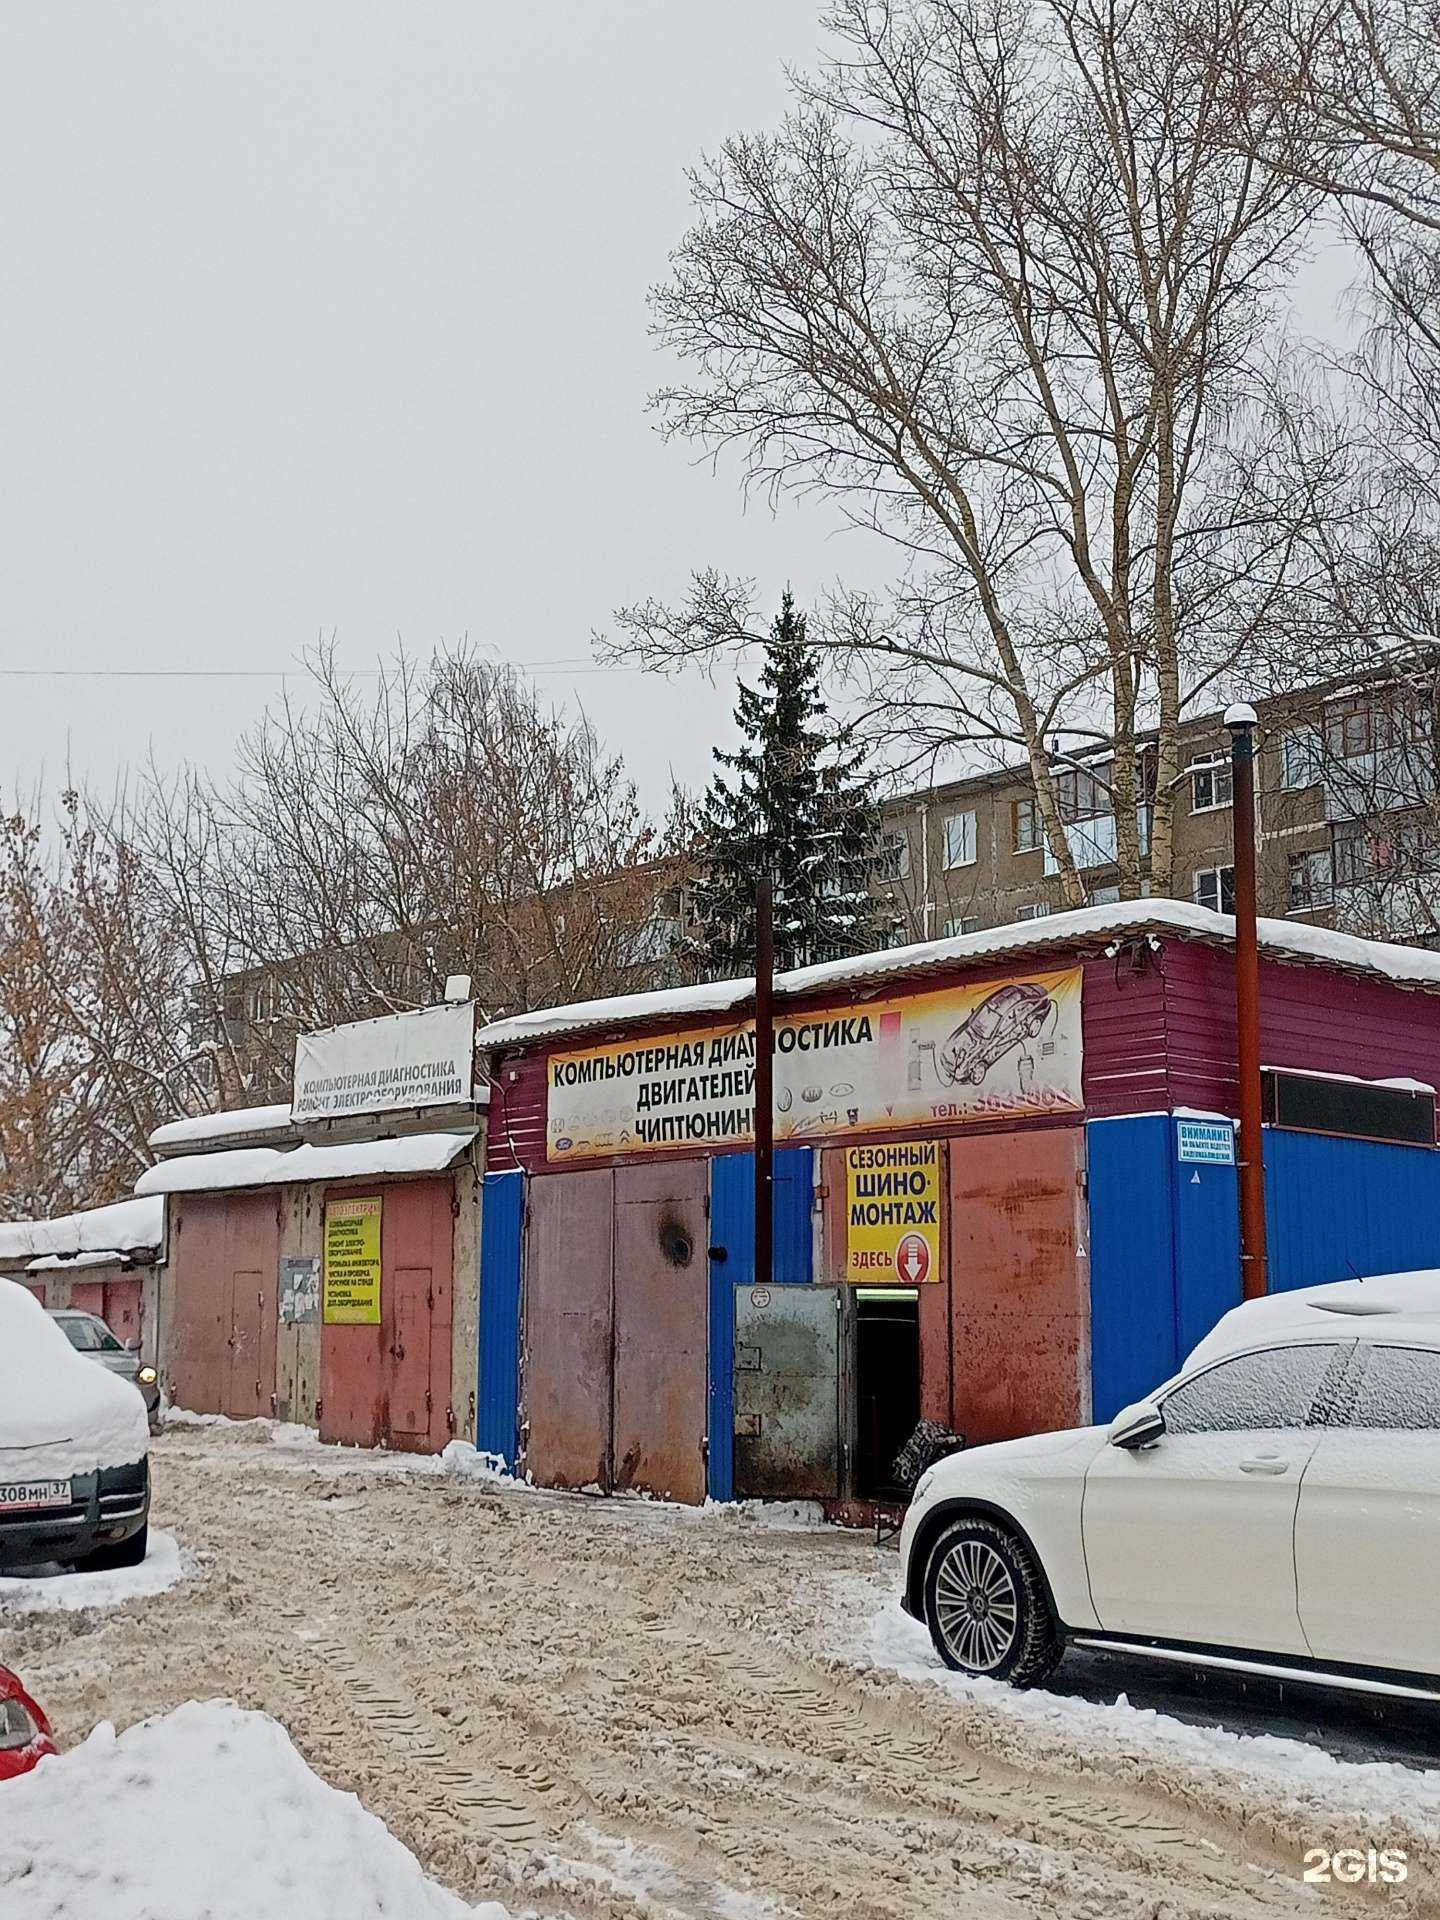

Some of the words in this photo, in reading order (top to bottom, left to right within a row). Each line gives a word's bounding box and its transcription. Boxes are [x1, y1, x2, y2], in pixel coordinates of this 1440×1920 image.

[554, 1041, 704, 1087] КОМПЬЮТЕРНАЯ
[303, 1072, 376, 1095] КОМПЬЮТЕРНАЯ
[377, 1061, 455, 1087] ДИАГНОСТИКА
[636, 1063, 756, 1112] ДВИГАТЕЛЕЙ
[297, 1096, 330, 1112] РЕМОНТ
[1182, 1127, 1230, 1141] ВНИМАНИЕ!
[849, 1139, 935, 1169] СЕЗОННЫЙ
[851, 1201, 937, 1226] МОНТАЖ
[852, 1252, 893, 1269] ЗДЕСЬ
[53, 1482, 67, 1494] 37
